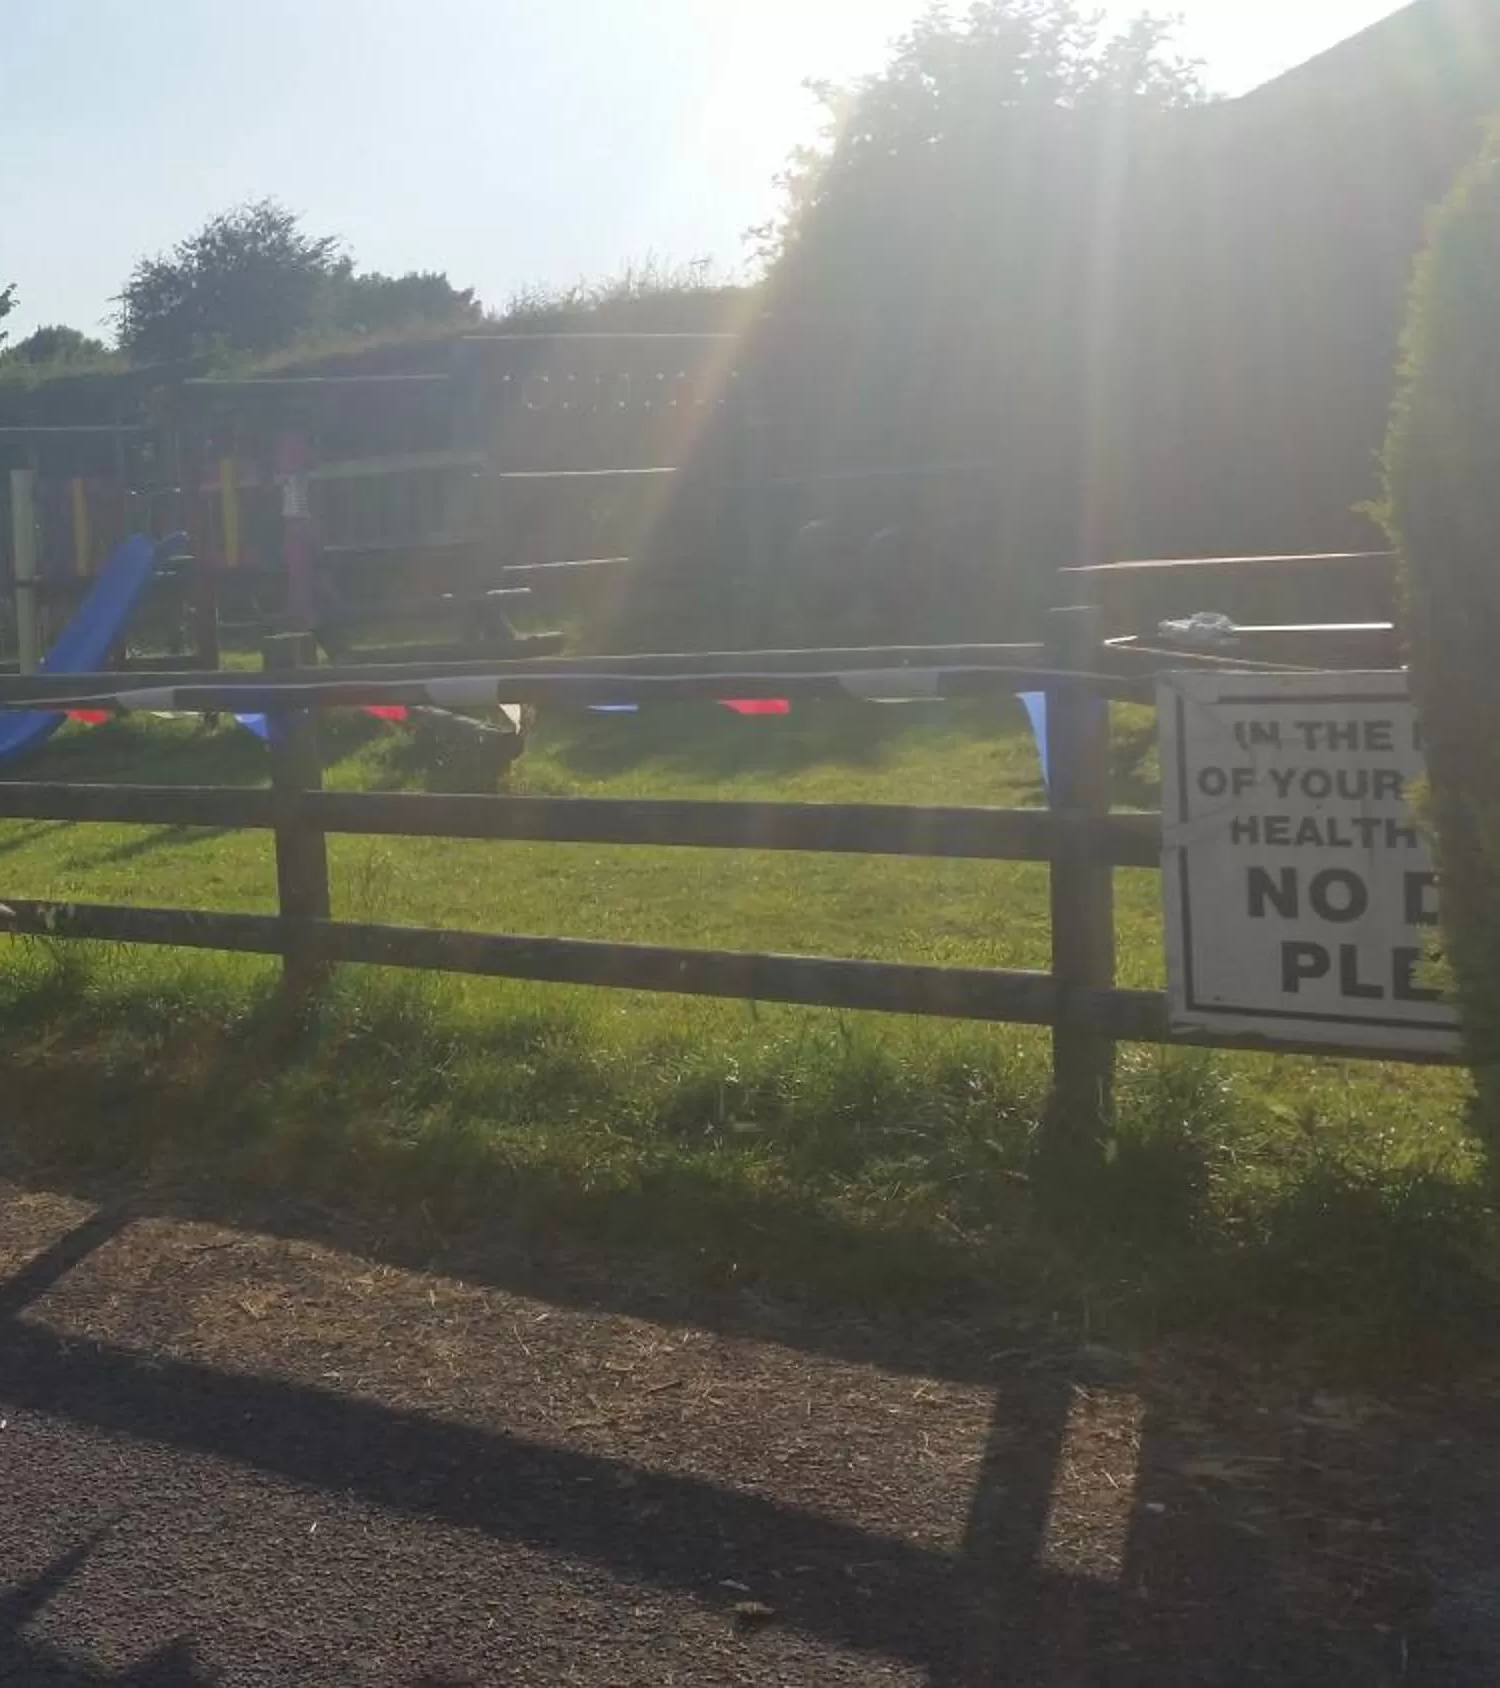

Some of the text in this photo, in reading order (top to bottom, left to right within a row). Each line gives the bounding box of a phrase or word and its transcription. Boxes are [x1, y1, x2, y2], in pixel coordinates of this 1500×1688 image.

[1234, 720, 1282, 750] IN
[1294, 720, 1395, 752] THE
[1197, 767, 1406, 801] OF YOUR
[1230, 815, 1419, 849] HEALTH
[1246, 866, 1368, 924] NO
